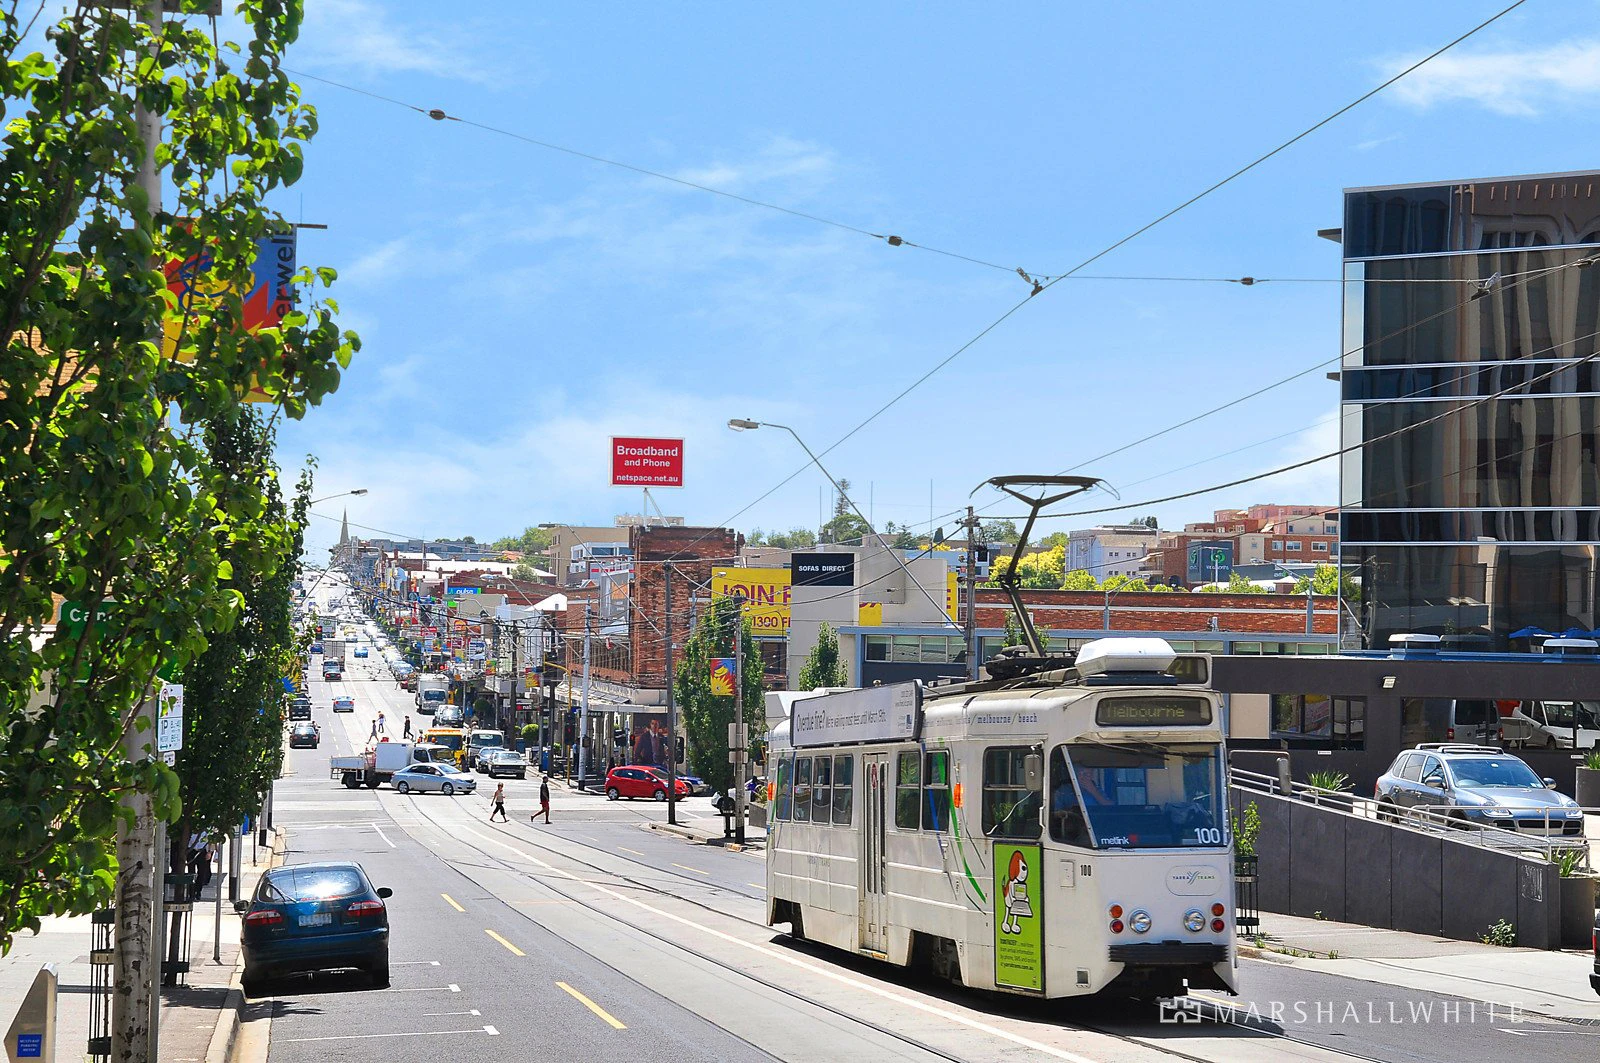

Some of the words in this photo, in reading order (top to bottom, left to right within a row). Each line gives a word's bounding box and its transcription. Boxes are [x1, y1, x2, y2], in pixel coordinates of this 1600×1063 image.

[616, 445, 679, 457] Broadband
[624, 459, 641, 467] and
[643, 459, 670, 467] Phone
[616, 474, 679, 483] netspace.net.au
[724, 584, 775, 606] JOIN
[752, 616, 778, 628] 1300
[977, 714, 1011, 724] melbourne
[1018, 712, 1038, 722] beach
[1100, 837, 1129, 845] metlink
[1194, 828, 1221, 844] 100
[1080, 864, 1092, 877] 100
